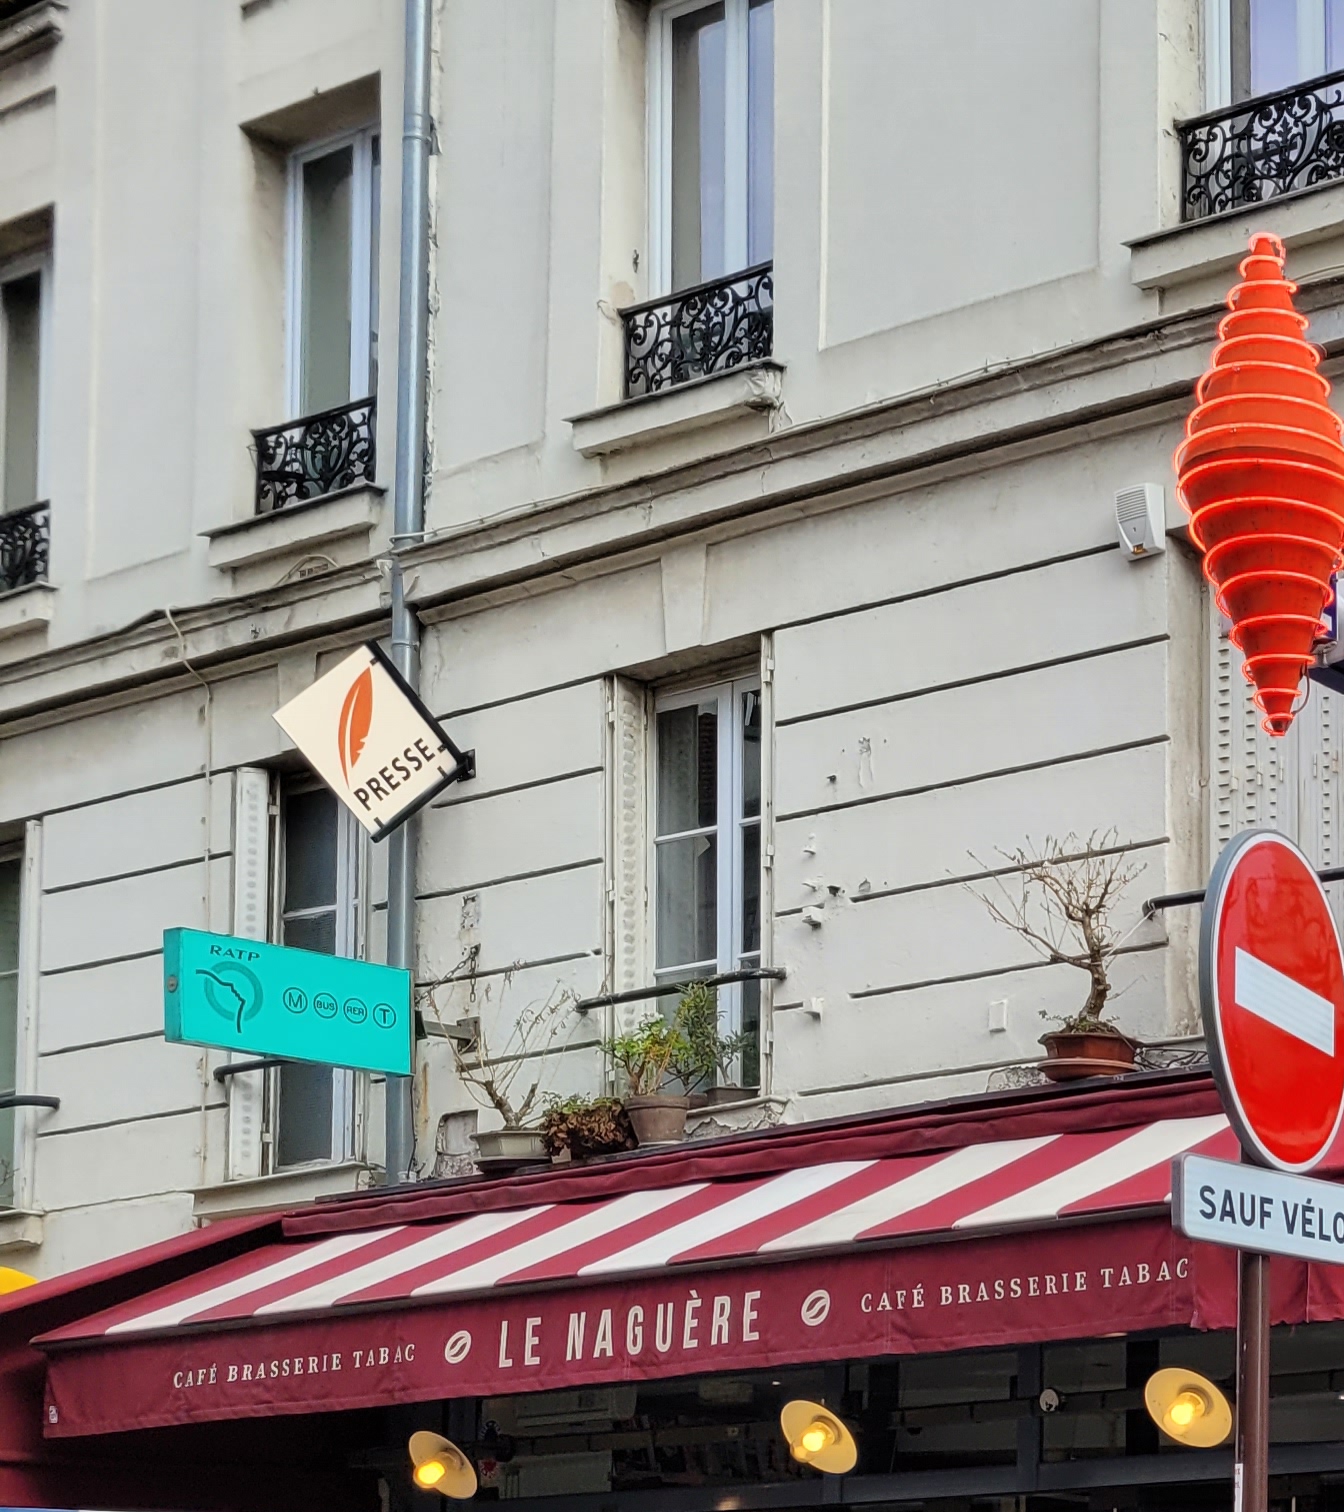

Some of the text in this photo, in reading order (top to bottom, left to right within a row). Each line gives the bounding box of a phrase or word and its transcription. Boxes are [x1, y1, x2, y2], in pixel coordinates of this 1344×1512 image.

[353, 737, 435, 812] PRESSE
[209, 944, 261, 962] RATP
[288, 991, 391, 1024] M BUS RER T
[1199, 1185, 1274, 1231] SAUF
[860, 1257, 1191, 1314] CAFÉ BRASSERIE TABAC
[498, 1288, 762, 1369] LE NAGUÈRE
[173, 1342, 417, 1390] CAFÉ BRASSERIE TABAC
